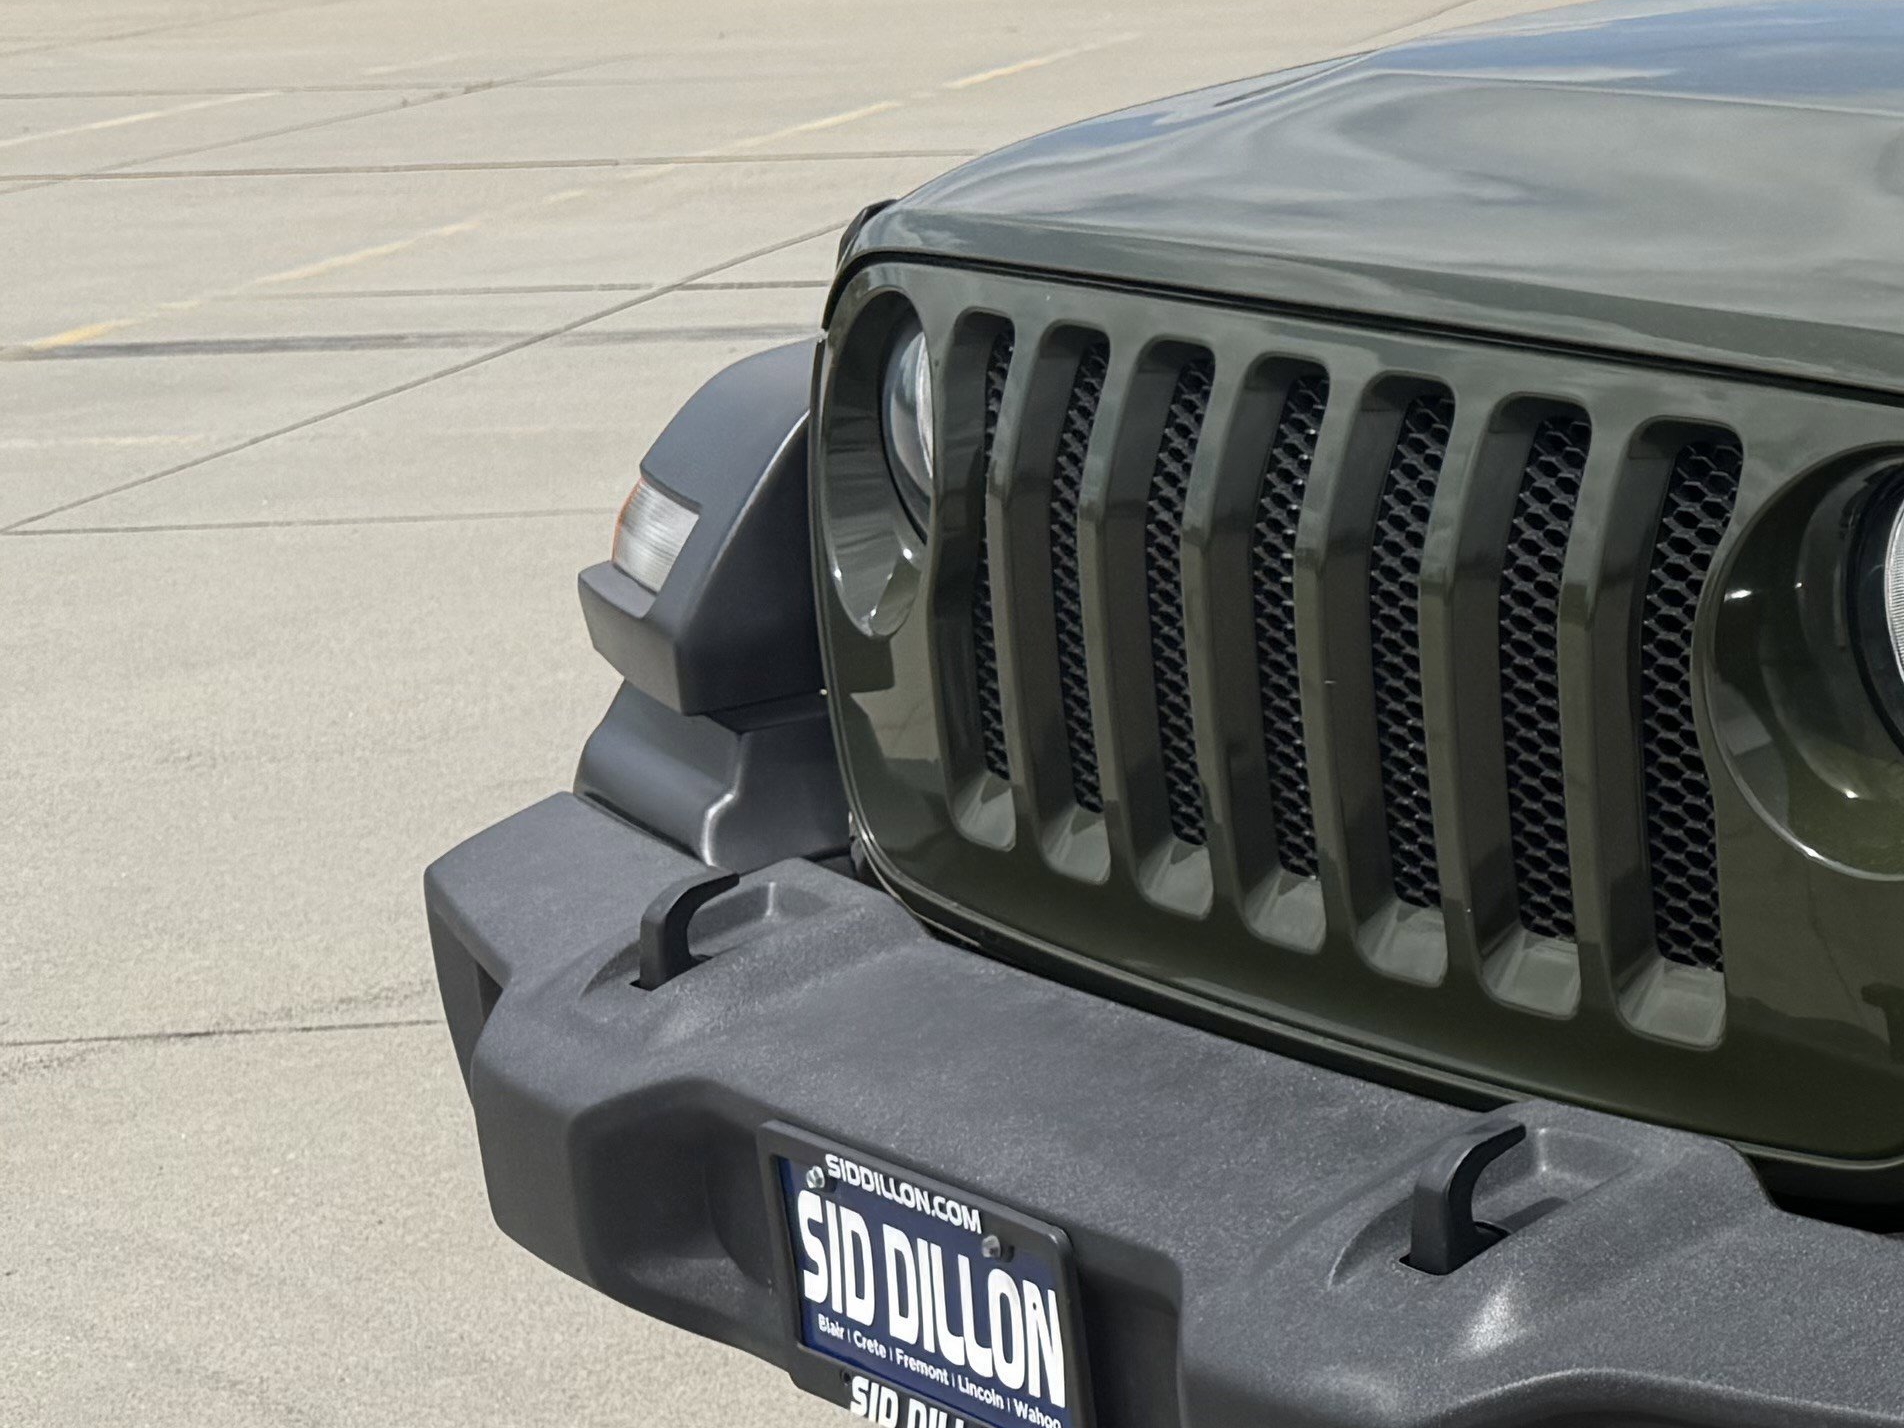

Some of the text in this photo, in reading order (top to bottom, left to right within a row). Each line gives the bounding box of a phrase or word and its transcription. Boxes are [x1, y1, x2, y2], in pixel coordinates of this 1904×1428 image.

[825, 1153, 982, 1234] SIDDILLON.COM
[797, 1190, 1066, 1409] SID DILLON
[818, 1313, 846, 1341] Blair
[853, 1330, 887, 1361] Crete
[896, 1347, 949, 1388] Fremont
[958, 1376, 1005, 1411] Lincoln
